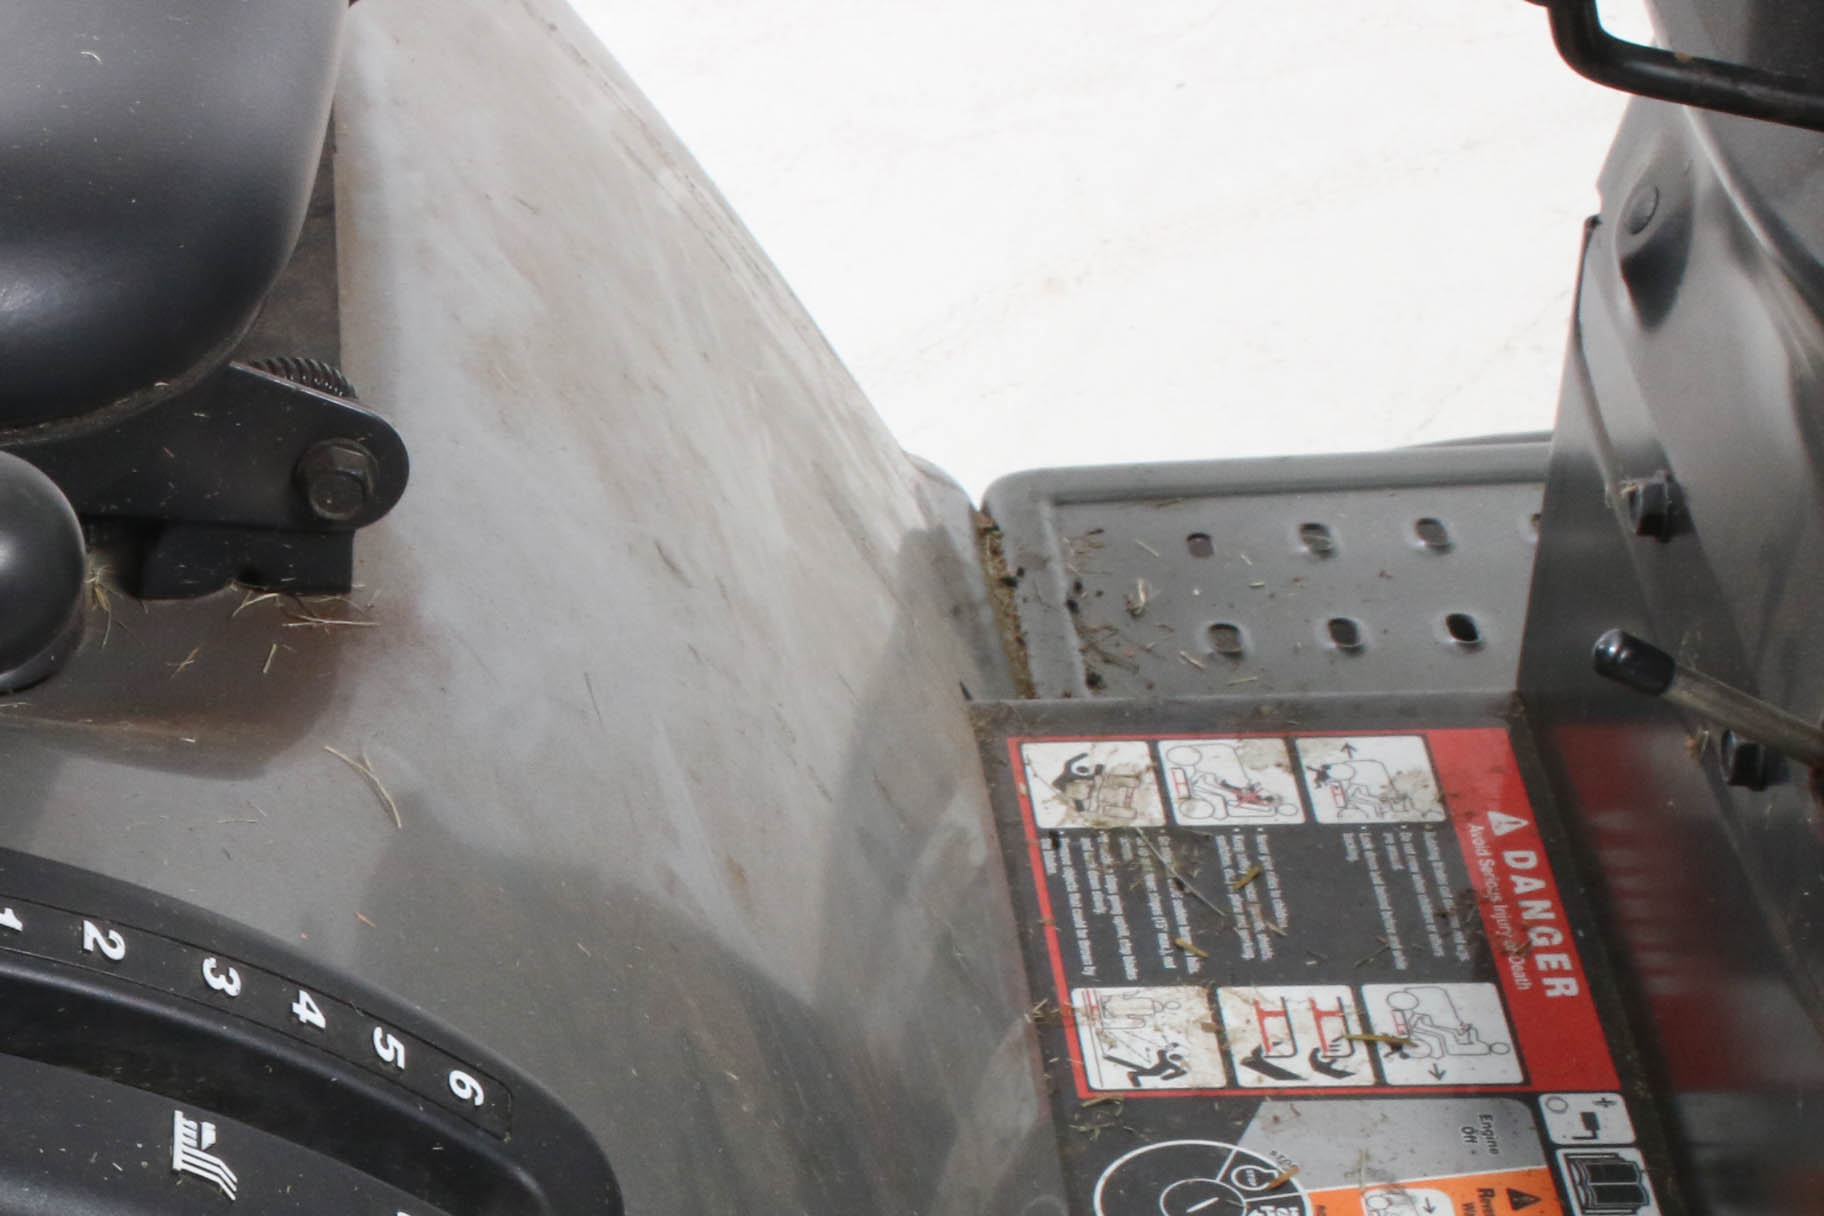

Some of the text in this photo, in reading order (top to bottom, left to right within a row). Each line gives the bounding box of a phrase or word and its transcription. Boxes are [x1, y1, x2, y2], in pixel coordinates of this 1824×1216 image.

[1467, 823, 1490, 856] Avoid
[1477, 857, 1501, 901] Serious
[82, 919, 127, 962] 2
[1489, 903, 1512, 937] Injury
[1501, 850, 1579, 997] DANGER
[202, 956, 242, 997] 3
[1507, 955, 1532, 989] Death
[291, 989, 327, 1030] 4
[373, 1026, 406, 1070] 5
[448, 1069, 485, 1107] 6
[1460, 1125, 1477, 1143] Off
[1478, 1113, 1499, 1154] Engine
